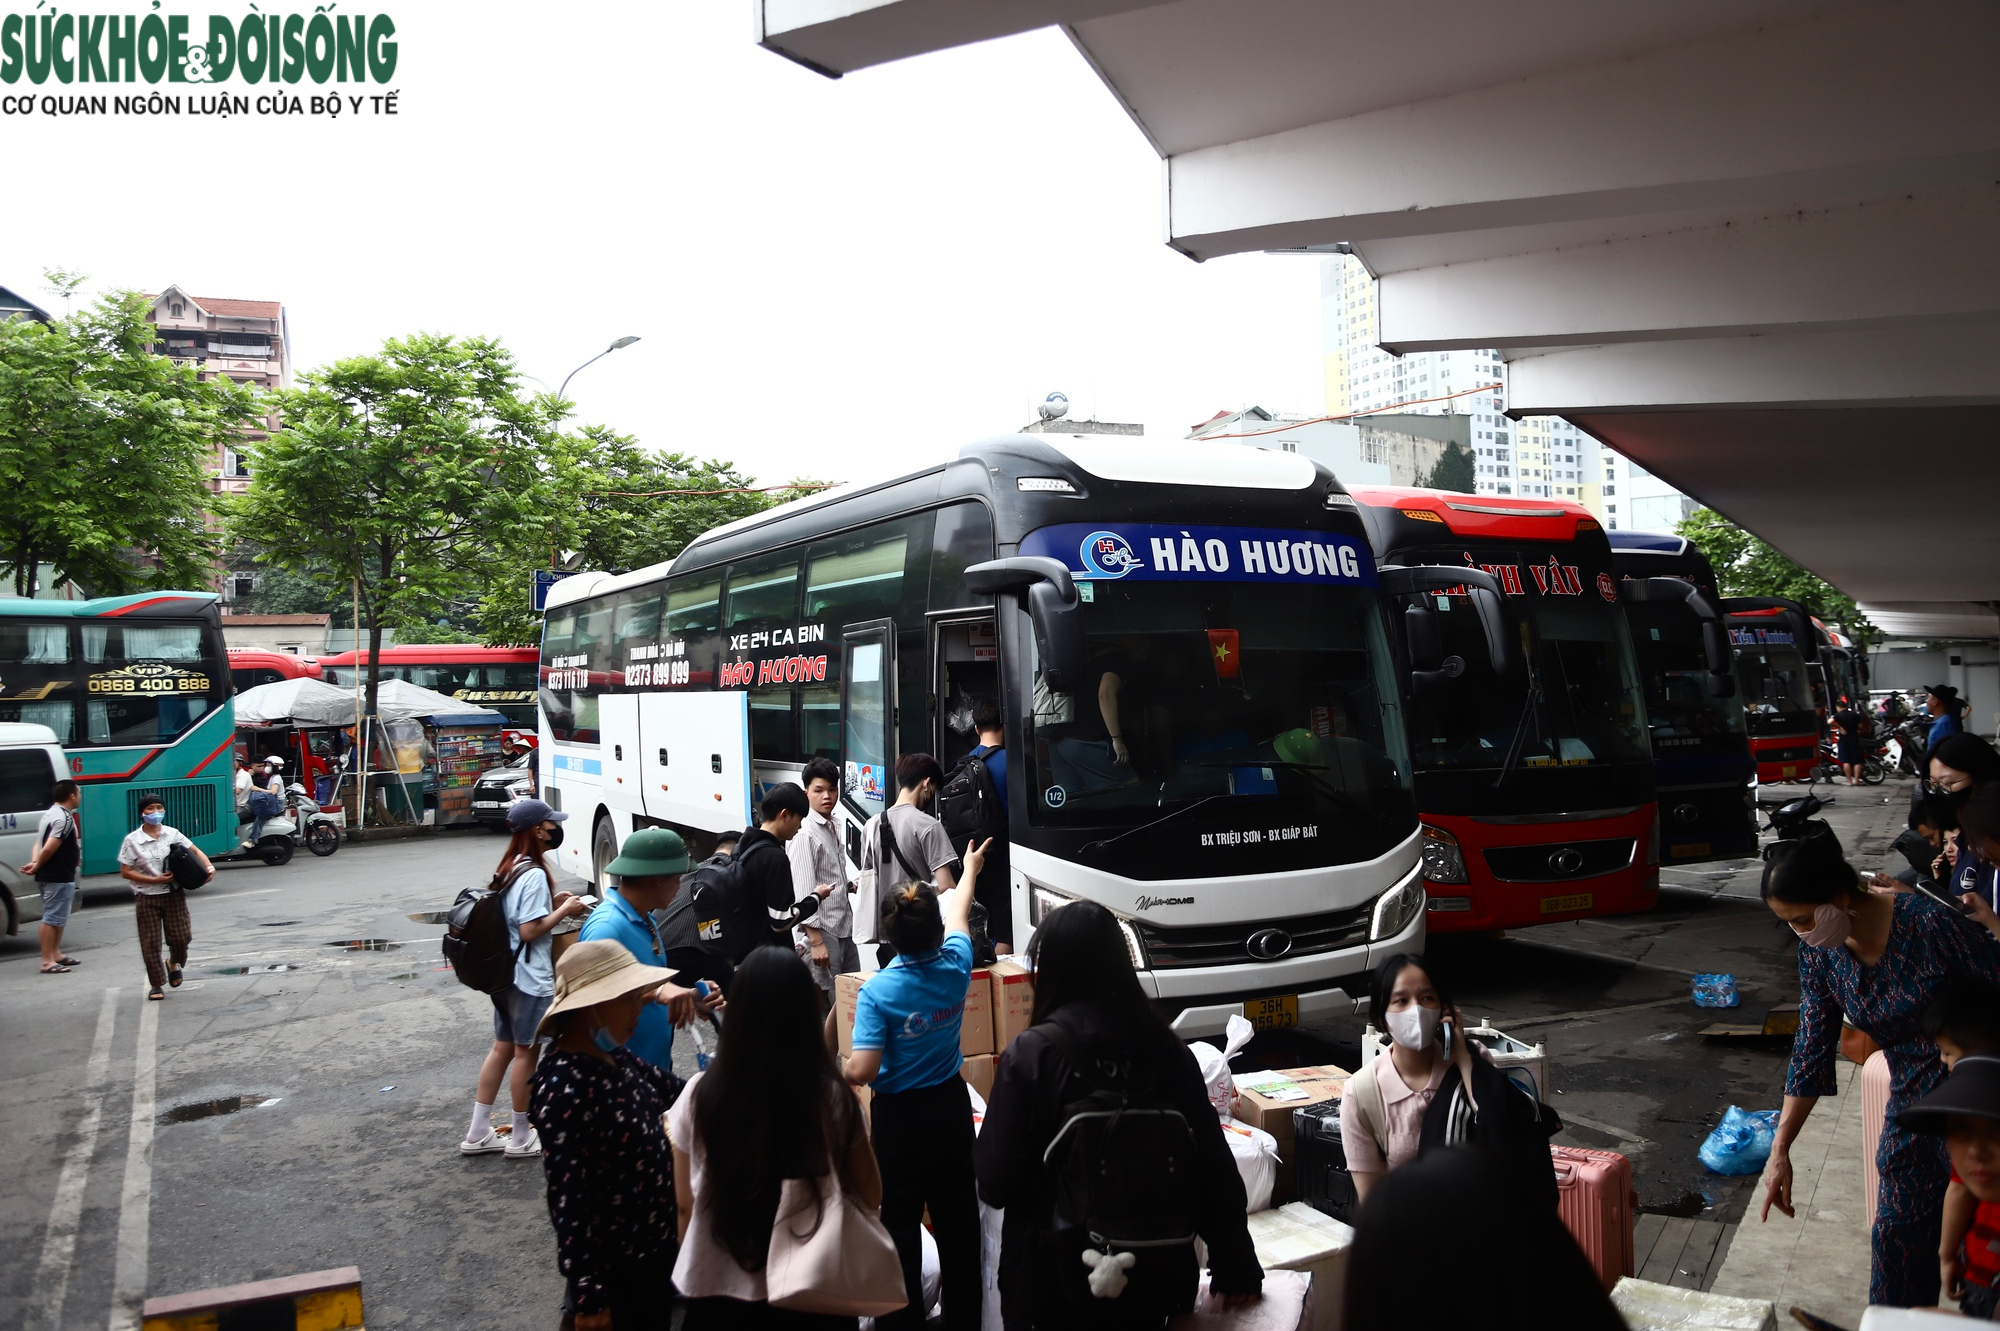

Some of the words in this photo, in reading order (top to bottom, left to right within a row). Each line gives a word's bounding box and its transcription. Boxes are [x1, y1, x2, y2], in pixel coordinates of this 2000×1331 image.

[1150, 531, 1230, 573] HÀO
[1240, 539, 1360, 578] HƯƠNG
[1529, 555, 1583, 596] VÂN
[730, 634, 748, 650] XE
[751, 631, 769, 648] 24
[772, 628, 794, 646] CA
[798, 624, 824, 644] BIN
[548, 672, 563, 690] 0373
[563, 670, 576, 689] 116
[577, 669, 589, 688] 118
[625, 664, 651, 686] 02373
[652, 662, 669, 685] 899
[671, 660, 689, 685] 899
[719, 656, 754, 688] HÀO
[758, 654, 827, 687] HƯƠNG
[88, 679, 135, 692] 0868
[140, 679, 174, 690] 400
[178, 678, 210, 690] 888
[1049, 792, 1062, 801] 1/2
[1201, 833, 1214, 846] BX
[1215, 829, 1241, 847] TRIỆU
[1242, 829, 1261, 844] SƠN
[1268, 829, 1281, 842] BX
[1281, 825, 1300, 840] GIÁP
[1302, 823, 1318, 838] BÁT
[698, 918, 723, 941] NIKE
[1260, 998, 1282, 1014] 36H
